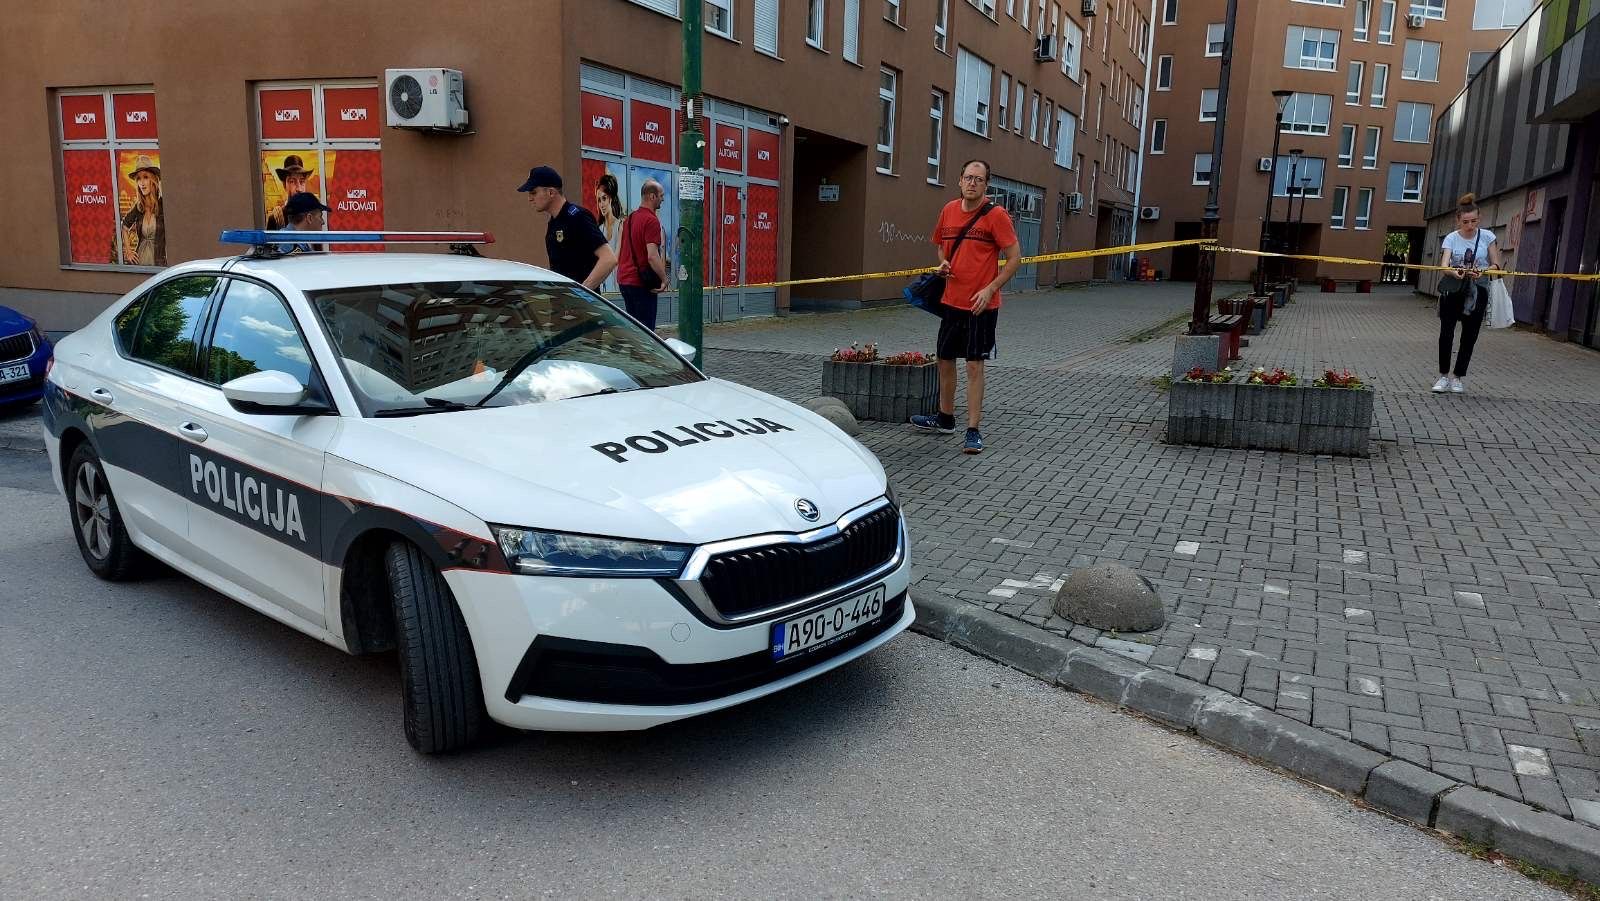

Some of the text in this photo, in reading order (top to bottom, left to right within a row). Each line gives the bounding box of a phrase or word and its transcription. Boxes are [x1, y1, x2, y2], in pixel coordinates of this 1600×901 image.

[638, 131, 665, 145] AUTOMATI
[718, 147, 739, 159] AUTOMATI
[75, 194, 107, 204] AUTOMATI
[337, 200, 377, 211] AUTOMATI
[590, 417, 795, 464] POLICIJA
[189, 453, 306, 543] POLICIJA
